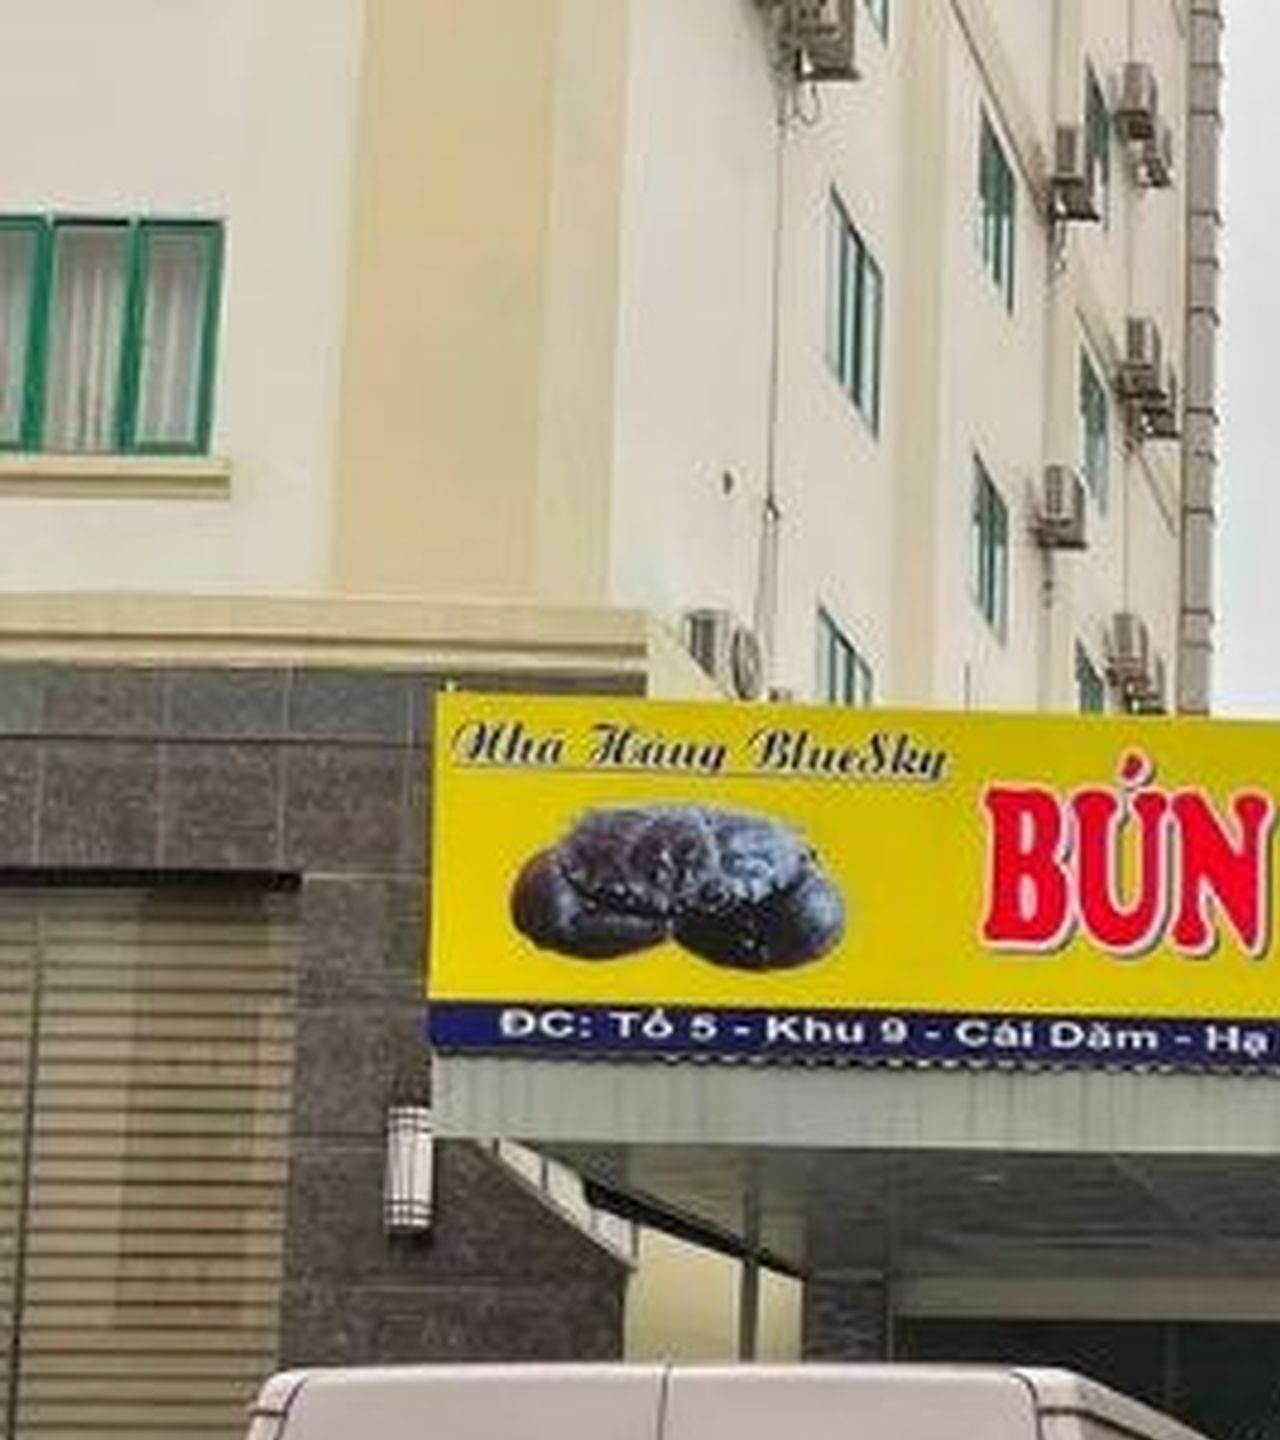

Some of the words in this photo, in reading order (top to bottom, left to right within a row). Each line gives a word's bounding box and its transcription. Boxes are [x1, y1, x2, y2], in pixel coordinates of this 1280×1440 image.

[747, 727, 948, 781] BlueSky
[979, 750, 1274, 958] BÚN
[499, 1008, 592, 1039] ĐC:
[765, 1015, 865, 1044] Khu
[881, 1016, 908, 1043] 9
[1205, 1025, 1270, 1058] Hạ
